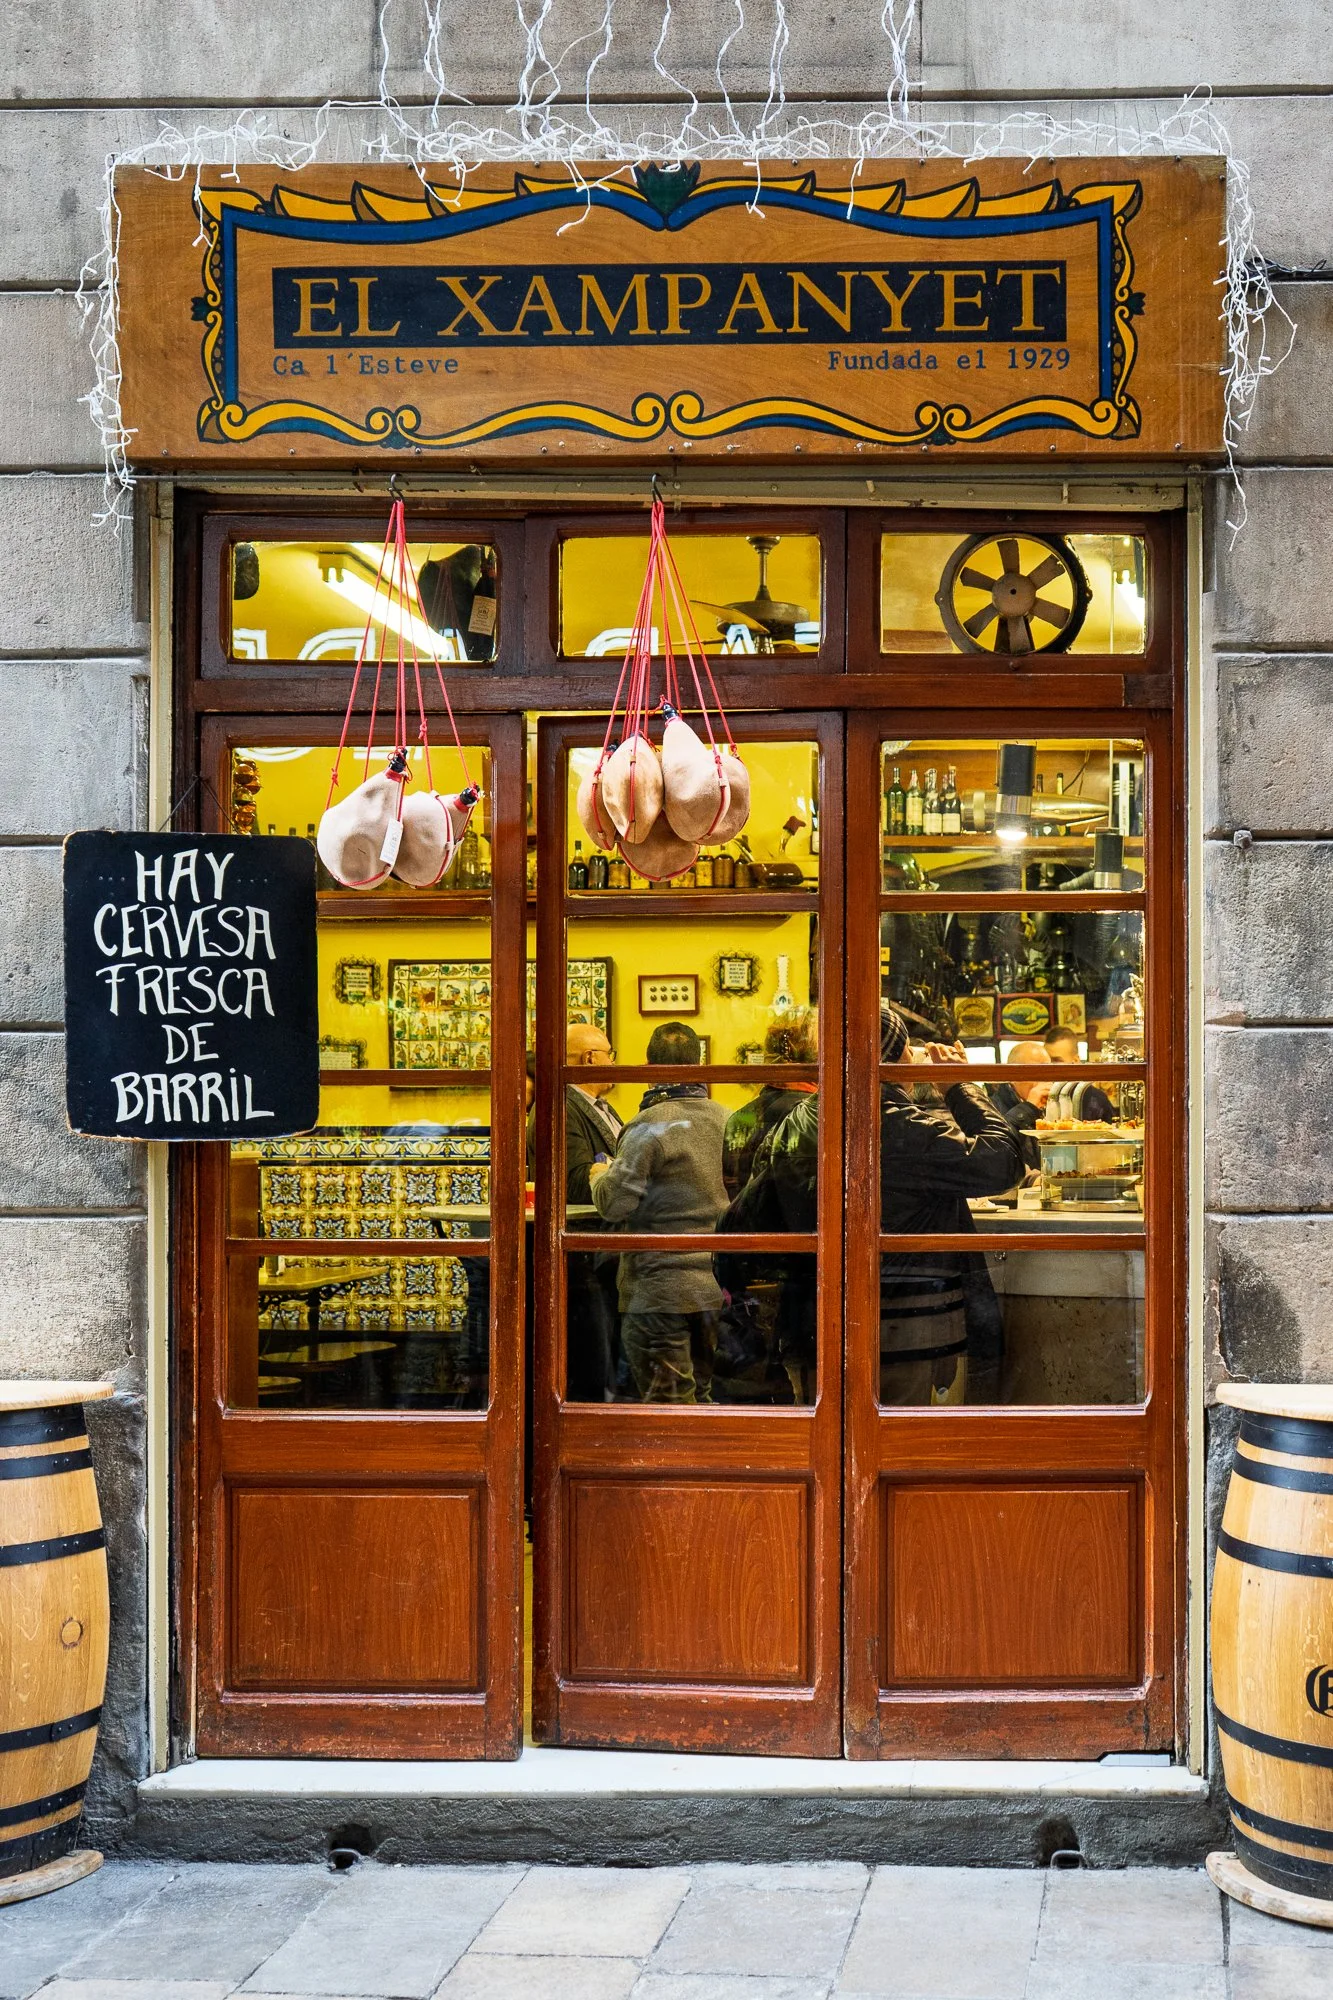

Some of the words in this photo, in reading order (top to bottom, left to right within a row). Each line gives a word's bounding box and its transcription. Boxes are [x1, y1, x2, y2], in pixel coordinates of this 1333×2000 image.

[292, 277, 400, 337] EL
[436, 266, 1061, 337] XAMPANYET
[272, 355, 305, 376] Ca
[827, 350, 939, 371] Fundada
[956, 348, 987, 370] el
[1007, 348, 1071, 371] 1929
[135, 849, 234, 903] HAY
[94, 903, 276, 960] CERVESA
[96, 963, 275, 1019] FRESCA
[162, 1022, 219, 1065] DE
